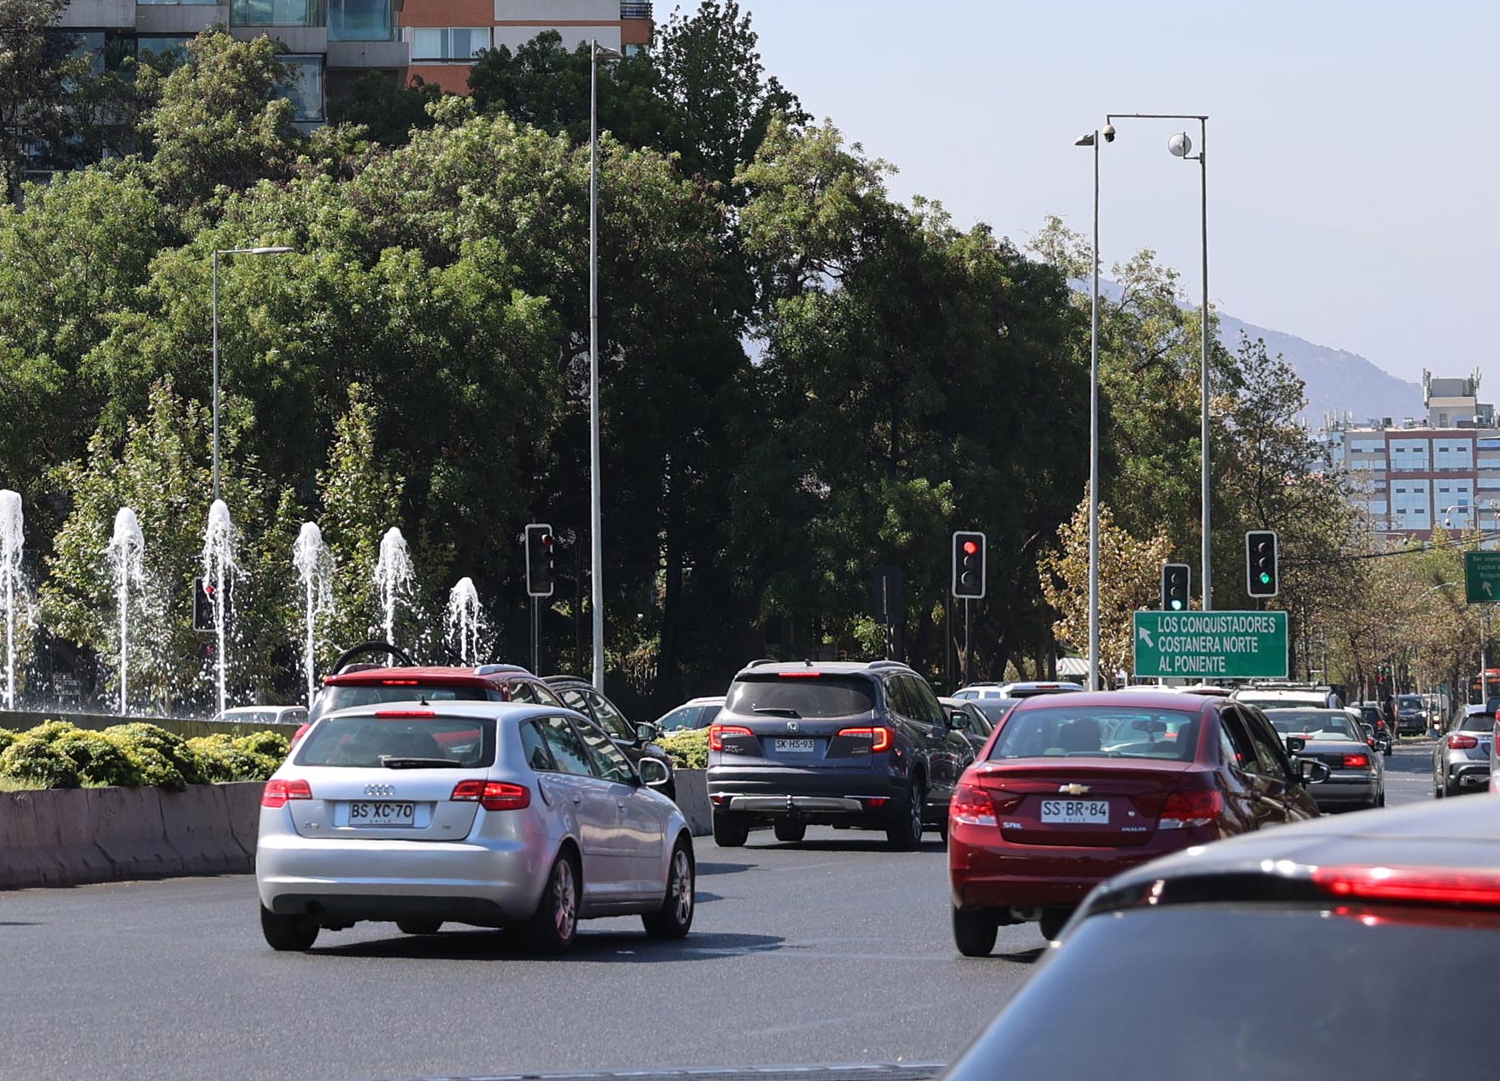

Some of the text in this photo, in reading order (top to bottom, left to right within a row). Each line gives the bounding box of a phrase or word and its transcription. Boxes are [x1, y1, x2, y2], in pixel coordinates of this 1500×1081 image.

[1157, 616, 1276, 634] LOS CONQUISTADORES
[1158, 636, 1258, 653] COSTANERA NORTE
[1159, 655, 1226, 672] AL PONIENTE
